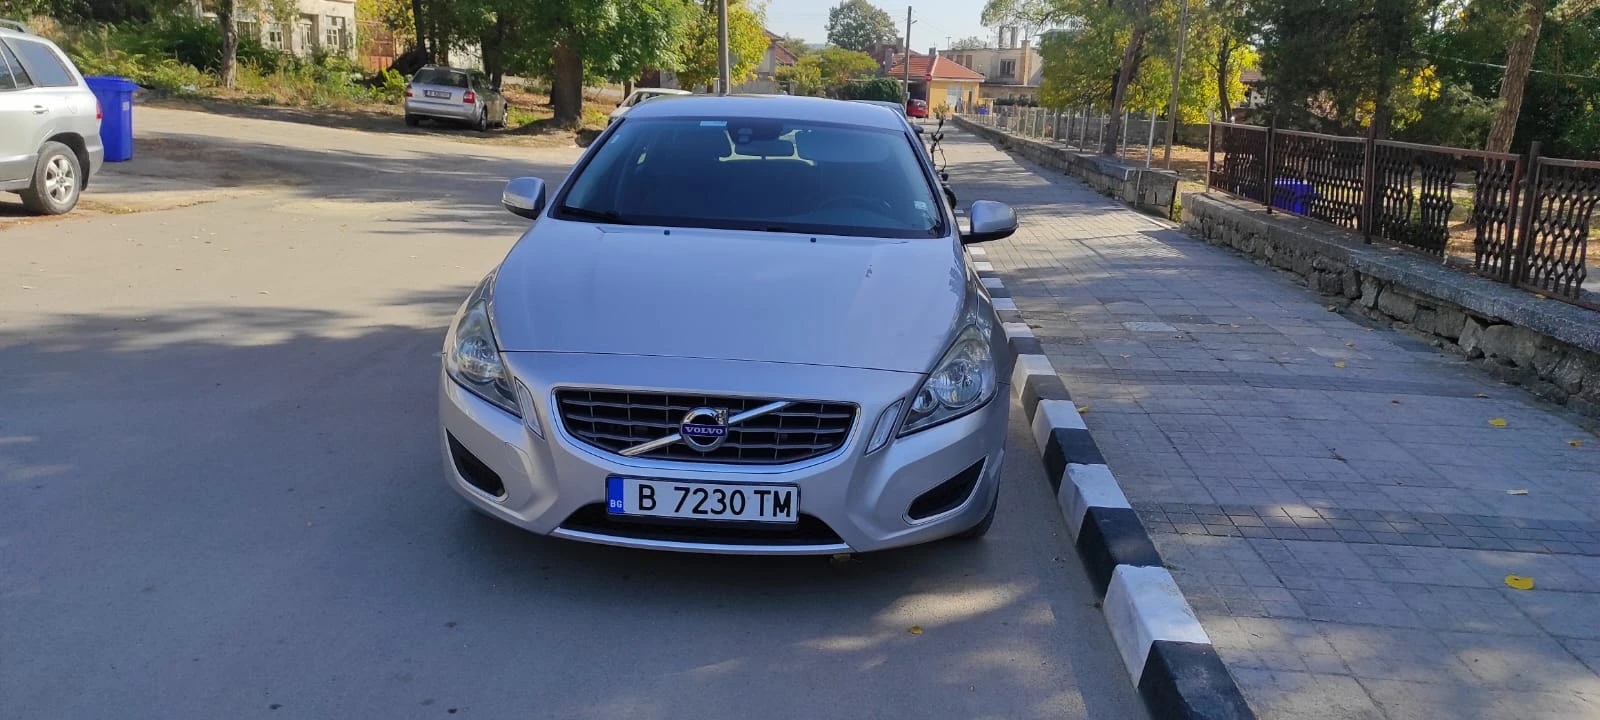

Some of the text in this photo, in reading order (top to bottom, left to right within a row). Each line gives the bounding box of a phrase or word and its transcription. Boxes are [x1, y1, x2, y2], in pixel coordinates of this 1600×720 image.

[684, 426, 723, 434] VOLVO
[610, 499, 622, 508] BG
[638, 484, 792, 517] B 7230 TM
